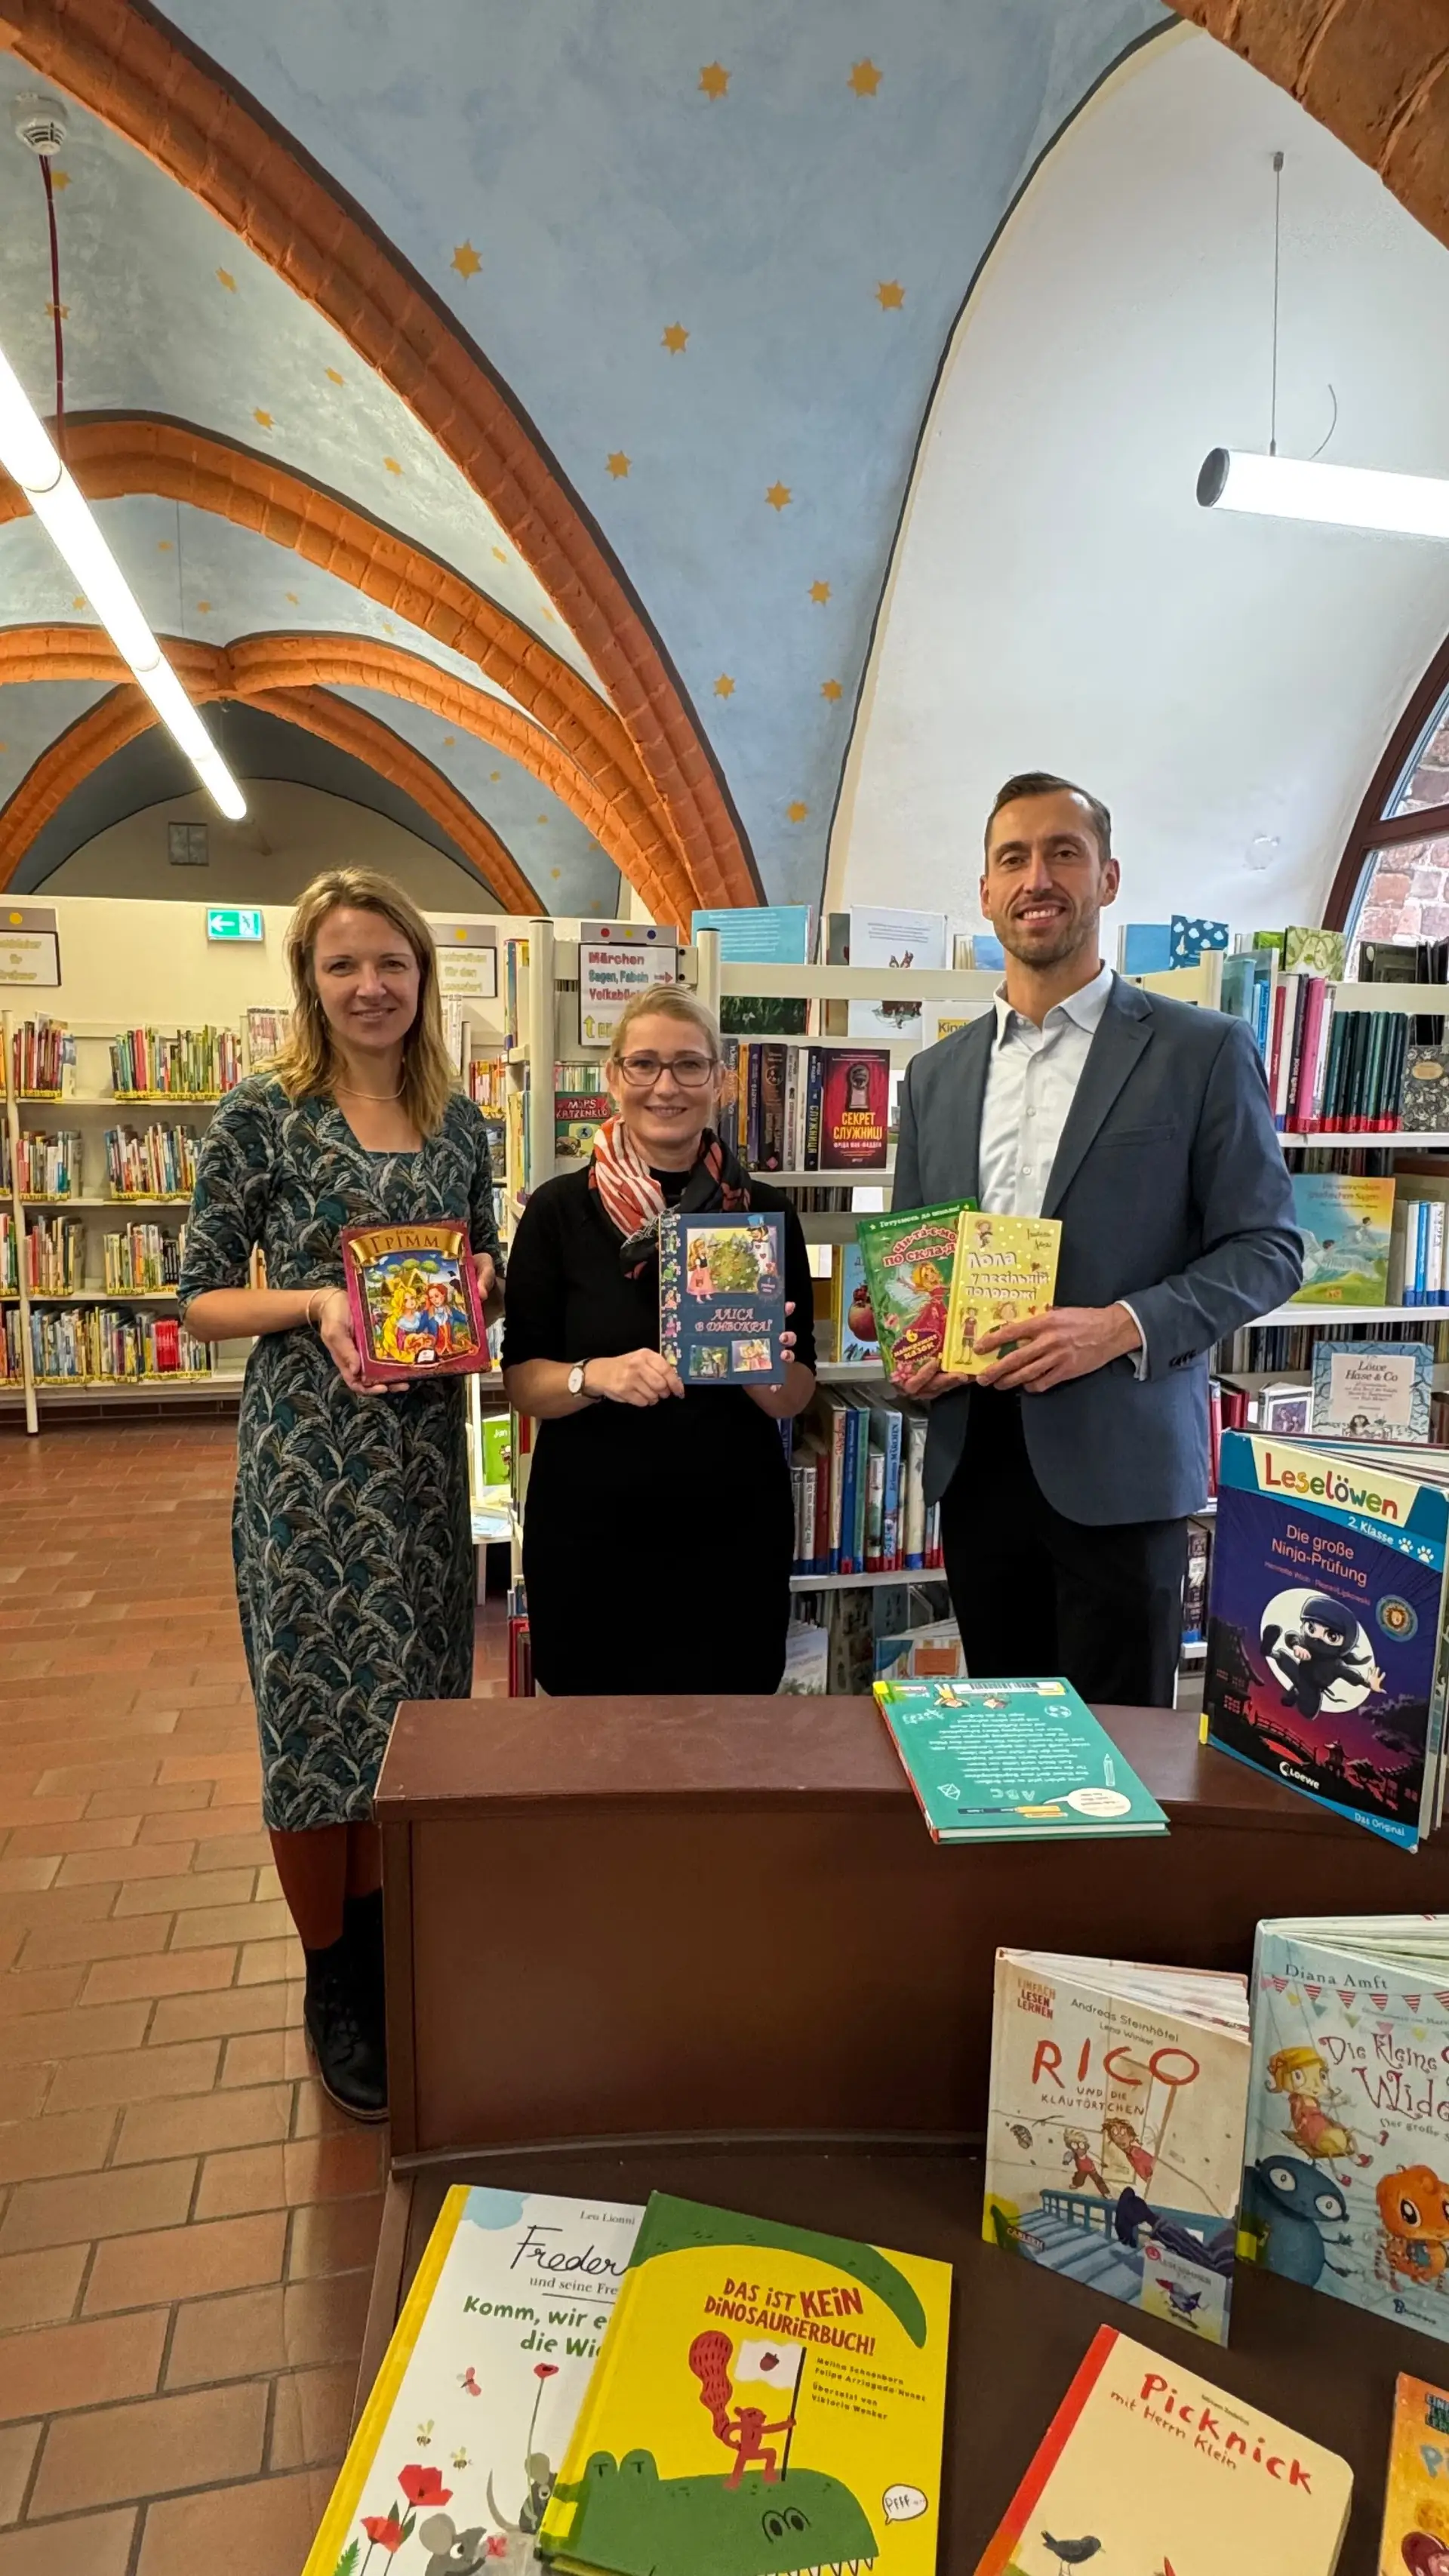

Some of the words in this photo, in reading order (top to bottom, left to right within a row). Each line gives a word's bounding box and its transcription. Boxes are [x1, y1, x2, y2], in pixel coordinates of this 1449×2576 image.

[589, 952, 645, 965] Märchen
[808, 1105, 819, 1154] СЛУЖНИЦЯ
[841, 1112, 876, 1125] СЕКРЕТ
[833, 1126, 883, 1140] СЛУЖНИЦІ
[968, 1251, 1017, 1269] Лола
[1345, 1370, 1373, 1382] Hase
[1383, 1371, 1398, 1382] Co
[1358, 1361, 1387, 1372] Löwe
[1265, 1453, 1398, 1519] Leselöwen
[1286, 1524, 1309, 1544] Die
[1313, 1536, 1354, 1560] große
[1347, 1516, 1358, 1529] 2.
[1360, 1521, 1394, 1546] Klasse
[1271, 1537, 1367, 1587] Ninja-Prüfung
[1355, 1812, 1371, 1826] Das
[1372, 1819, 1405, 1836] Original
[1285, 1964, 1337, 1985] Diana
[1343, 1974, 1389, 1990] Amft
[1017, 1997, 1054, 2020] LERNEN
[1022, 1990, 1051, 2008] LESEN
[1070, 1999, 1117, 2021] Andreas
[1120, 2014, 1180, 2043] Steinhöfel
[1100, 2022, 1121, 2036] Lena
[1032, 2037, 1200, 2088] RICO
[1318, 2036, 1366, 2066] Die
[1041, 2093, 1145, 2116] KLAUTÖRTCHEN
[1077, 2086, 1103, 2097] UND
[1111, 2091, 1127, 2101] DIE
[580, 2211, 599, 2221] Leo
[602, 2211, 635, 2226] Lionni
[530, 2276, 555, 2288] und
[558, 2281, 592, 2293] seine
[723, 2277, 760, 2302] DAS
[463, 2295, 540, 2325] Komm,
[549, 2308, 589, 2328] wir
[520, 2329, 558, 2353] die
[815, 2367, 842, 2380] Felipe
[817, 2357, 847, 2371] Melina
[812, 2393, 850, 2410] Viktoria
[813, 2381, 858, 2401] Übersetzt
[861, 2397, 878, 2406] von
[1110, 2390, 1137, 2411] mit
[1143, 2405, 1186, 2439] Herrn
[1194, 2434, 1237, 2470] Klein
[1140, 2373, 1312, 2495] Picknick
